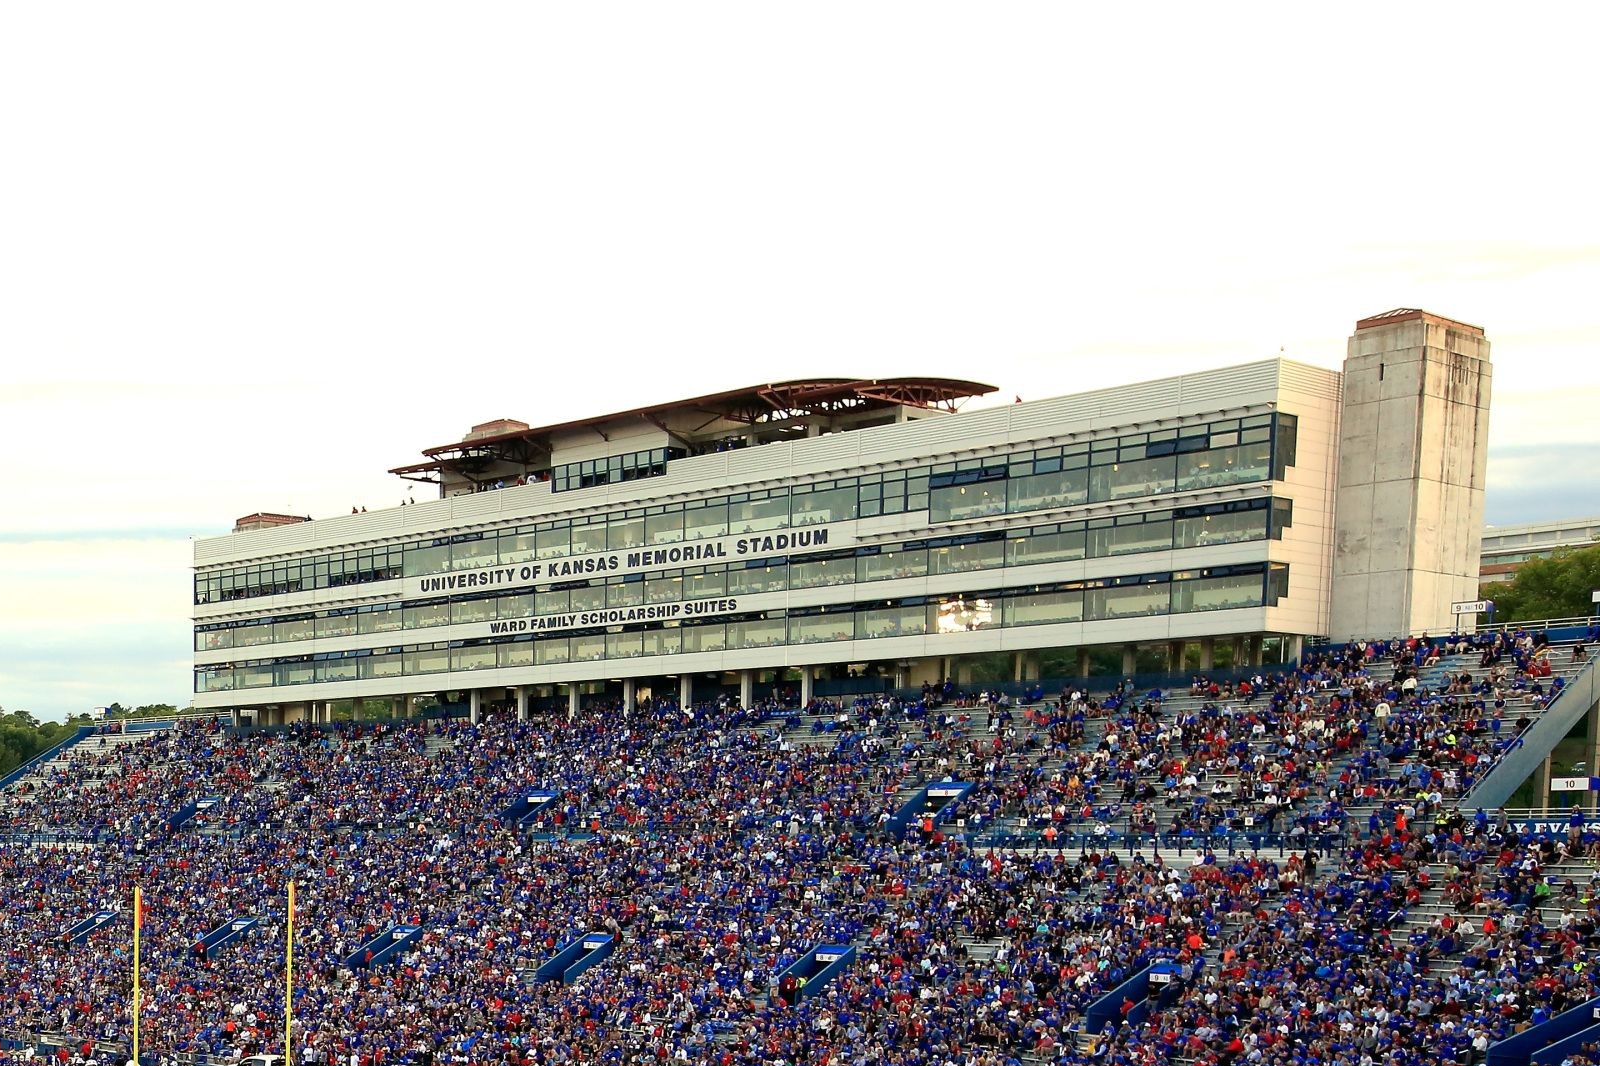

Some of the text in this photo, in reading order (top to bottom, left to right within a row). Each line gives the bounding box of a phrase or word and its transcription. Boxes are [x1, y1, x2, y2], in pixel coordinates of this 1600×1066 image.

[420, 528, 829, 593] UNIVERSITY OF KANSAS MEMORIAL STADIUM
[490, 598, 738, 634] WARD FAMILY SCHOLARSHIP SUITES
[1474, 603, 1484, 611] 10
[1564, 780, 1576, 788] 10
